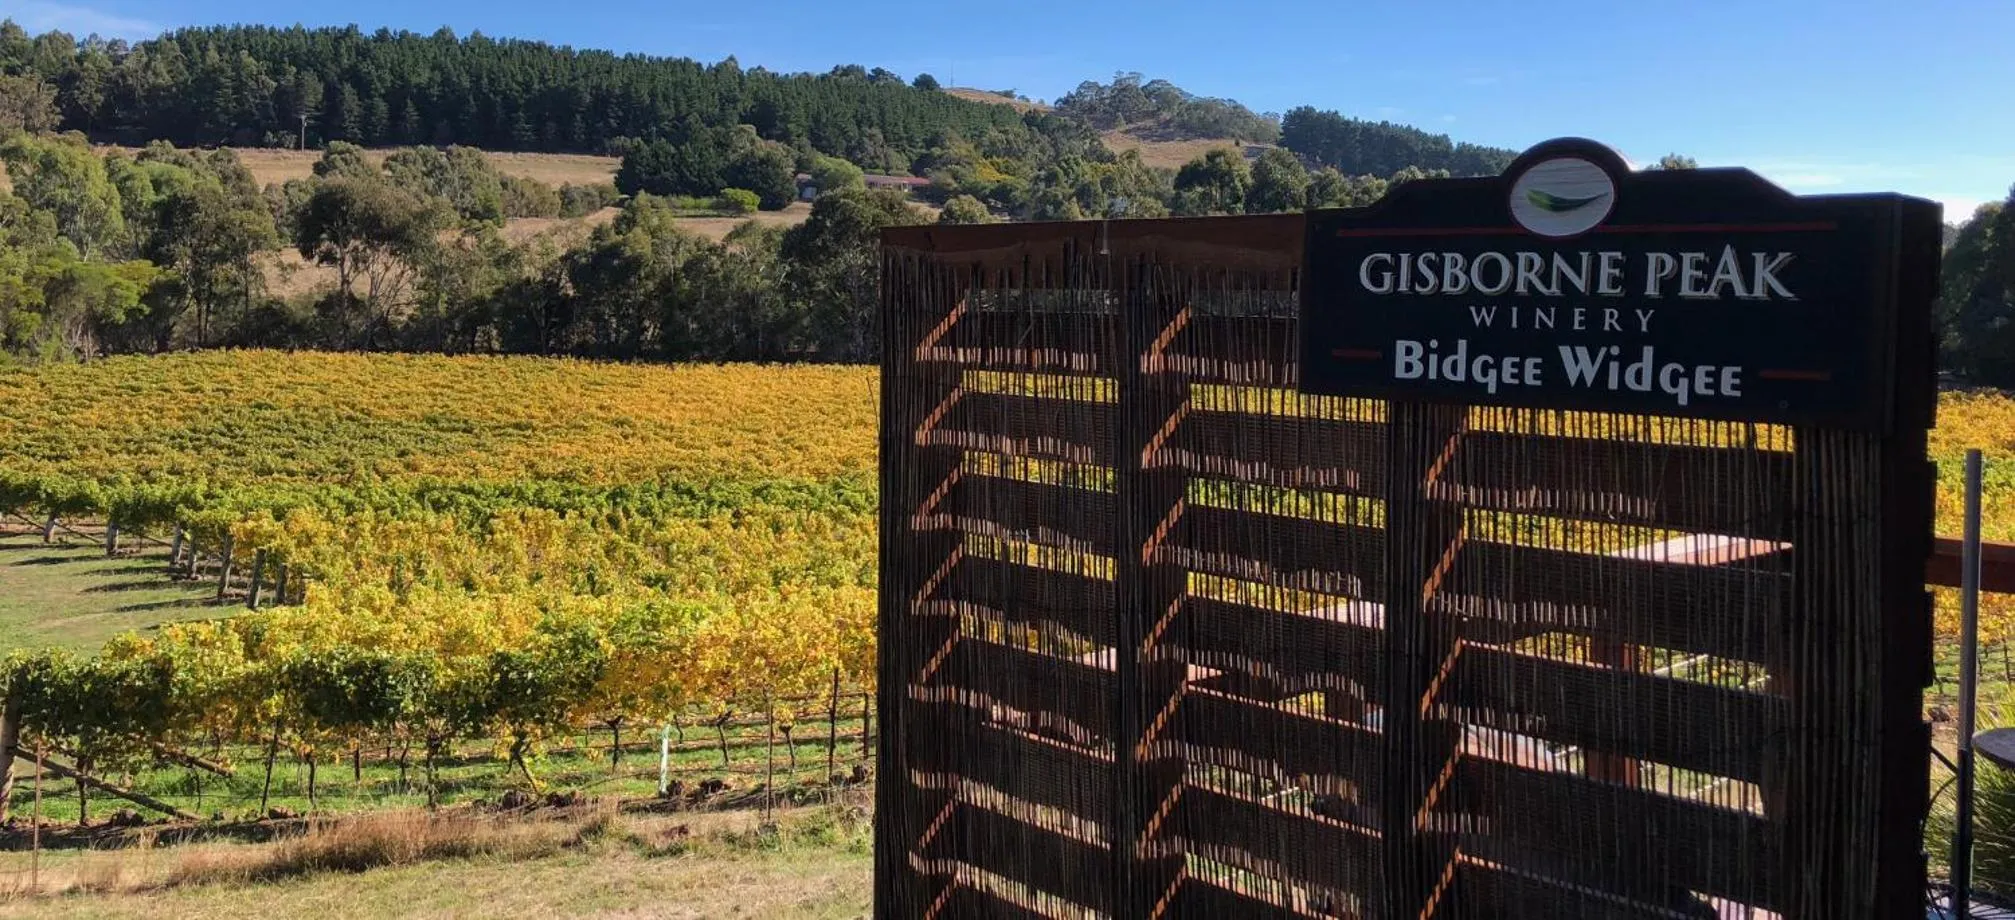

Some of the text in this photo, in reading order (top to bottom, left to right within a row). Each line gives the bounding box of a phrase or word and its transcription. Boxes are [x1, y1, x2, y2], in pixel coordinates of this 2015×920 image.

[1360, 244, 1796, 298] GISBORNE PEAK
[1469, 306, 1654, 333] WINERY
